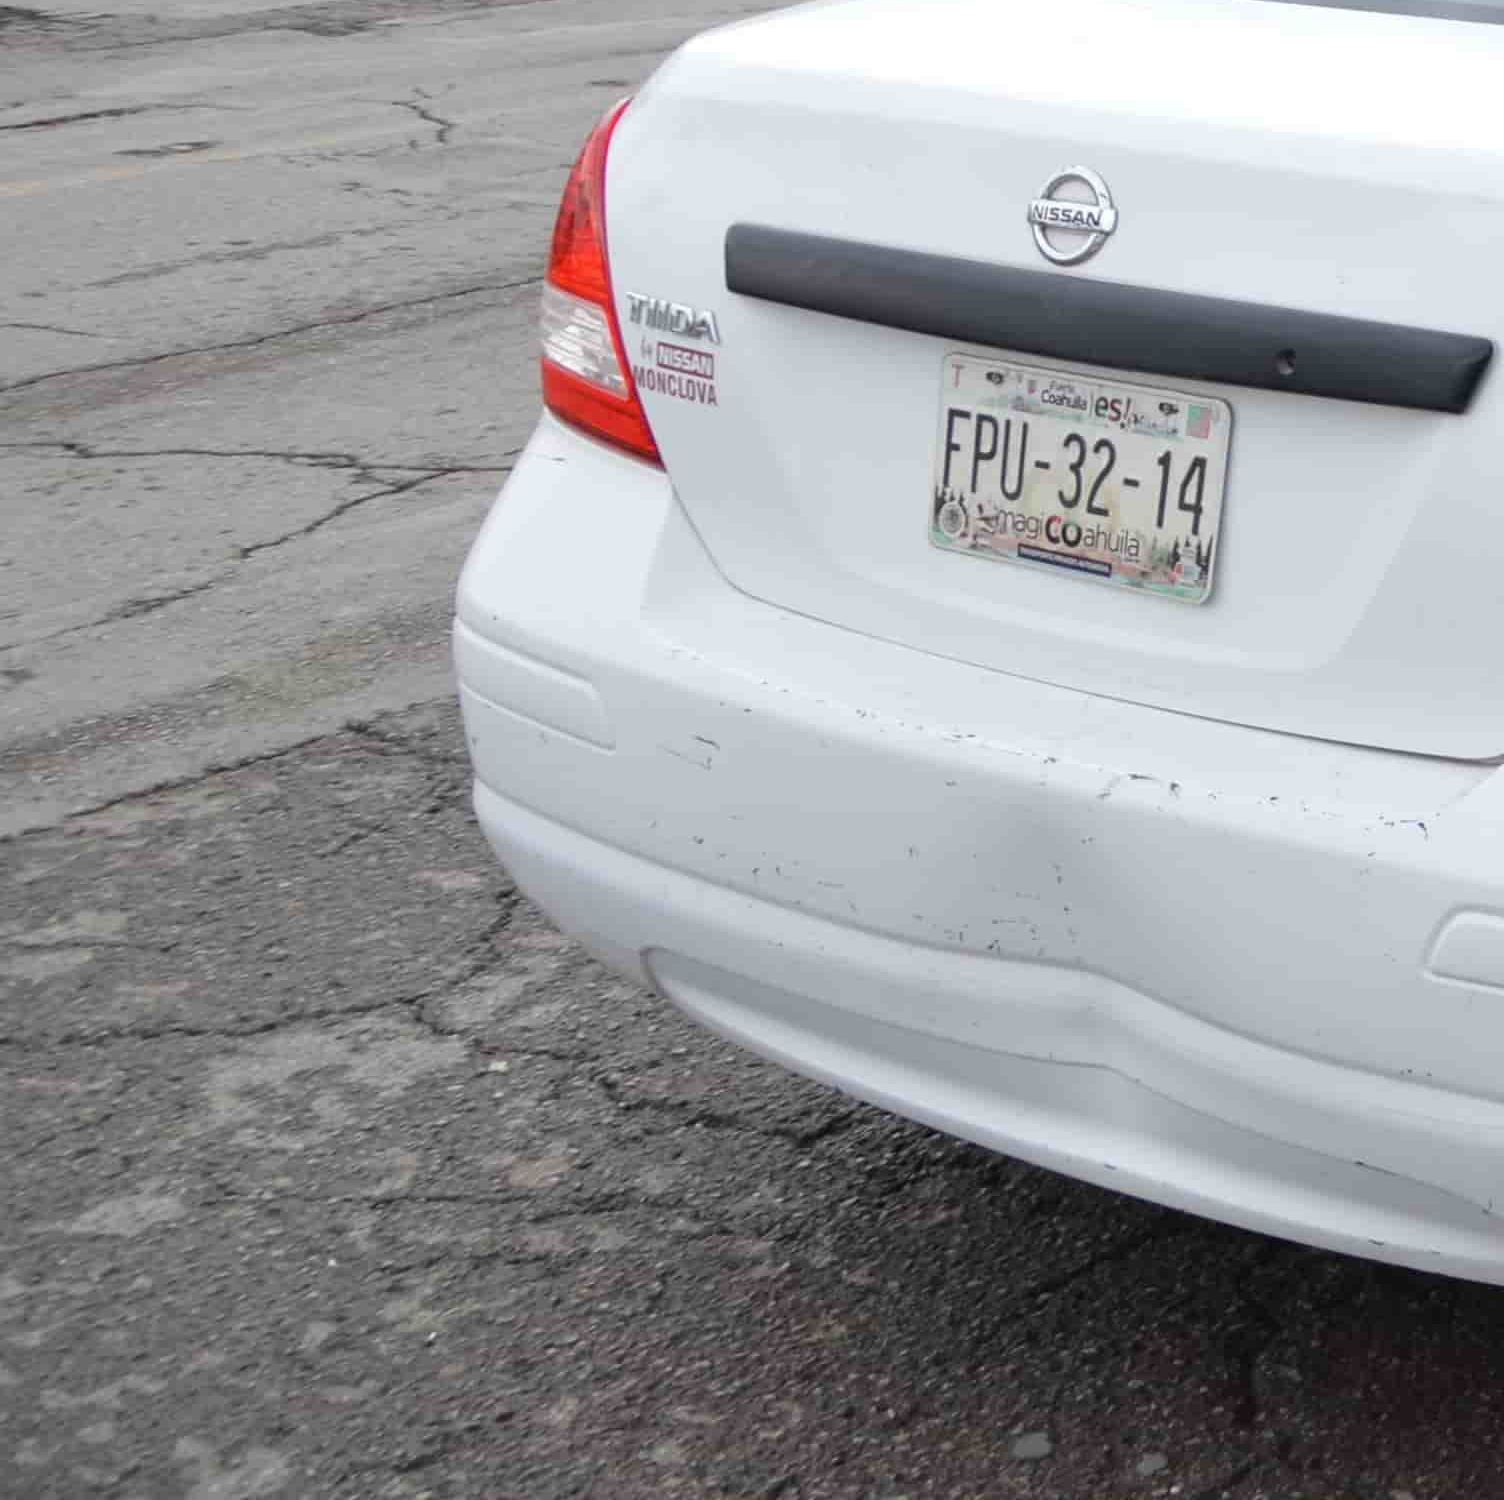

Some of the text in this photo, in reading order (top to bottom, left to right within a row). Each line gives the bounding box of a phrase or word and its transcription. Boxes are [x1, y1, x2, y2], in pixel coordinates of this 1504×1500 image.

[1032, 203, 1102, 228] NISSAN
[657, 343, 713, 379] NISSAN
[633, 365, 718, 406] MONCLOVA
[1040, 389, 1089, 411] Coahuila
[942, 406, 1207, 536] FPU-32-14
